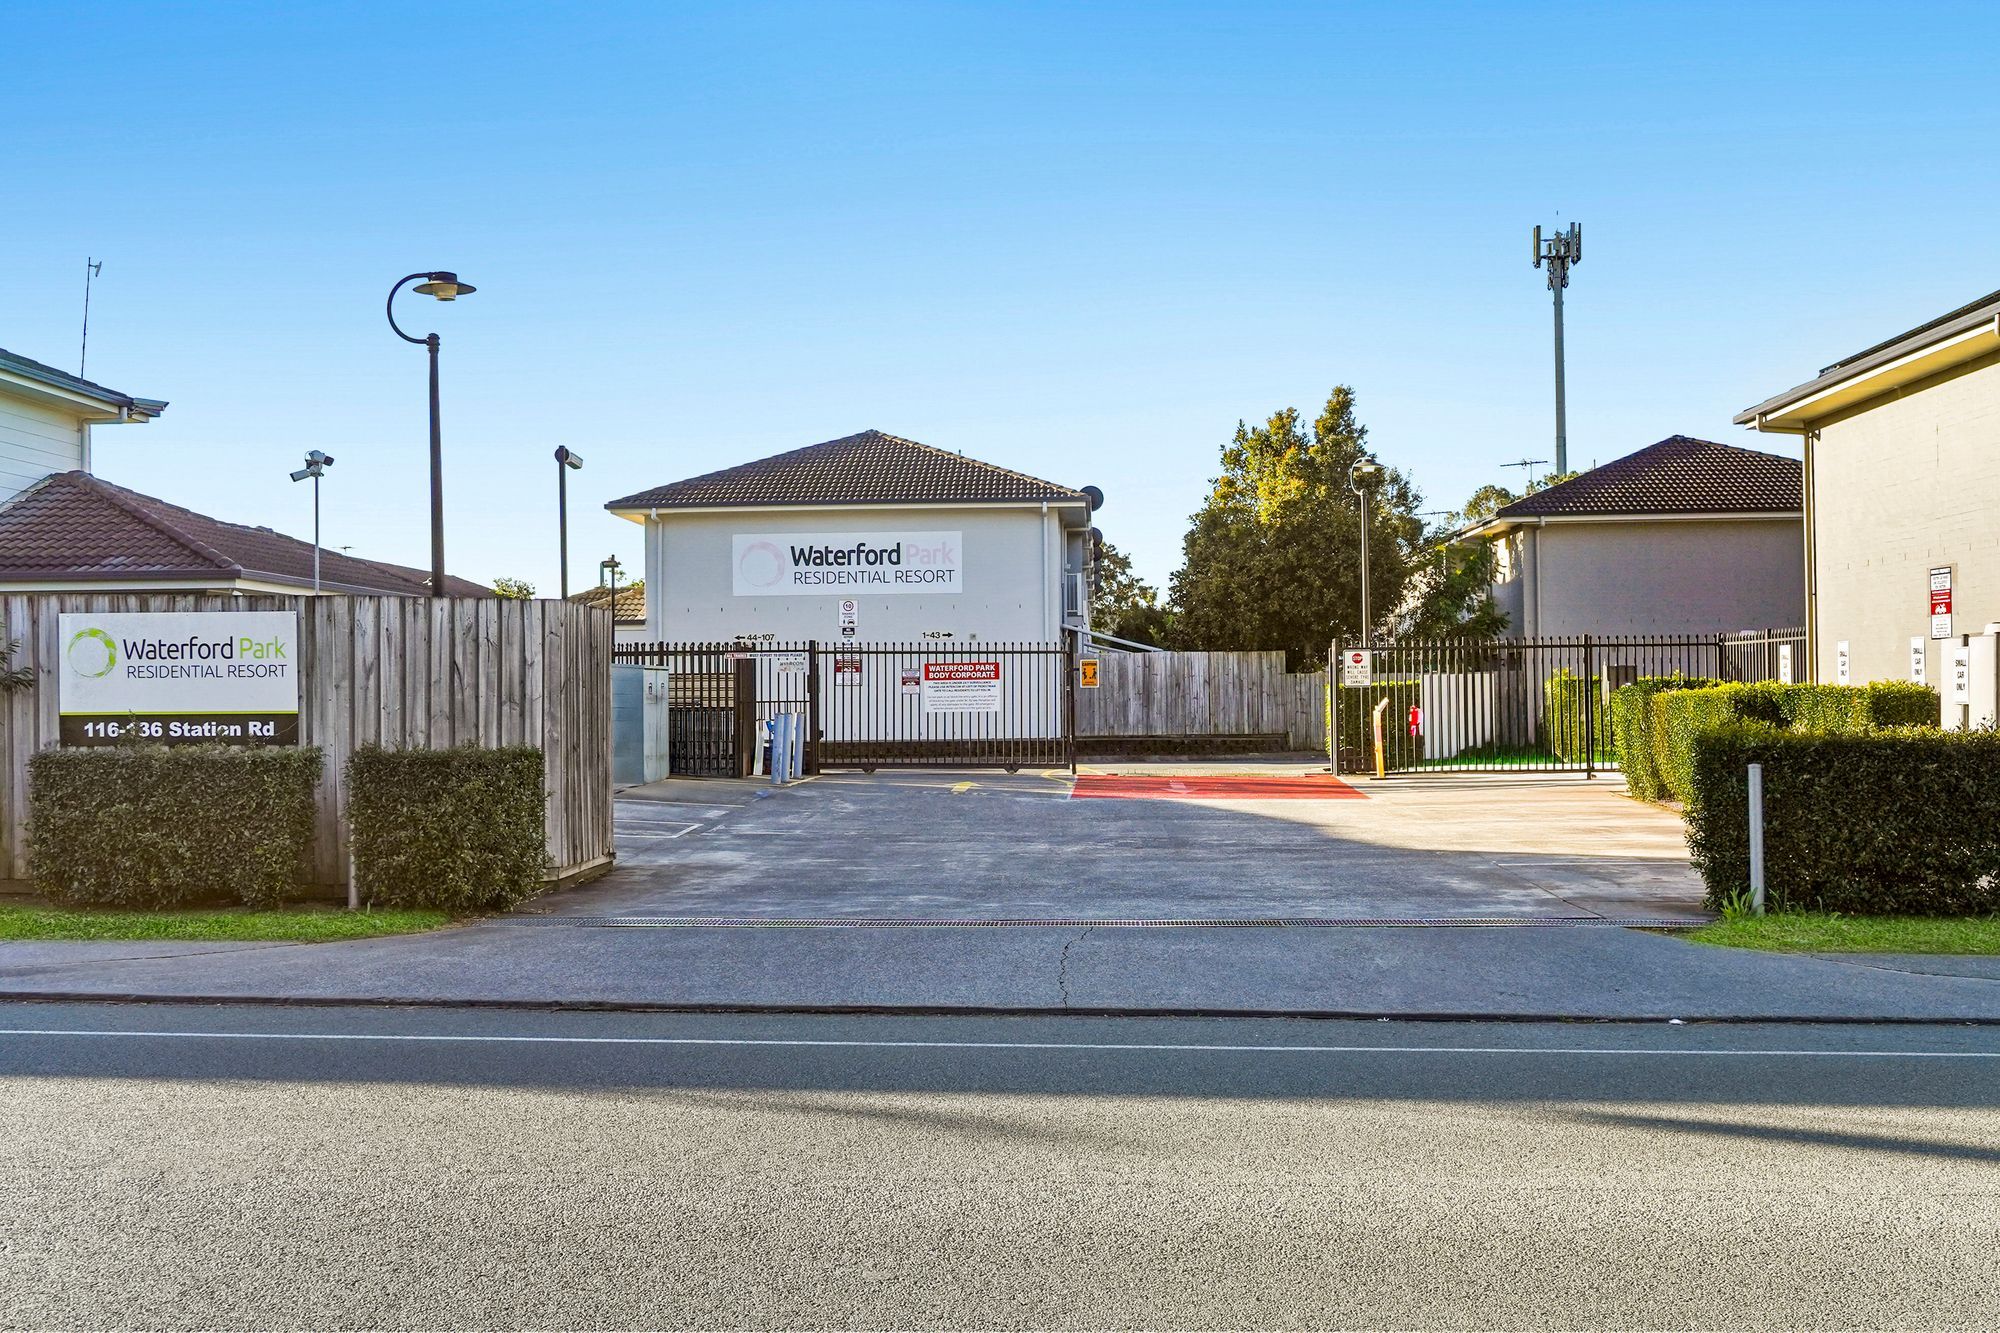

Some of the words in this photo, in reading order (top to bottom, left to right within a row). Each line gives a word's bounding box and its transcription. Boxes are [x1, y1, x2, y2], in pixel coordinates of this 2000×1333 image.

[790, 542, 901, 566] Waterford
[905, 542, 954, 565] Park
[794, 570, 890, 584] RESIDENTIAL
[895, 569, 955, 583] RESORT
[123, 636, 233, 660] Waterford
[239, 636, 287, 659] Park
[928, 664, 974, 672] WATERFORD
[1955, 659, 1967, 667] SMALL
[127, 664, 223, 679] RESIDENTIAL
[227, 664, 287, 678] RESORT
[1957, 671, 1965, 679] CAR
[1956, 683, 1966, 691] ONLY
[168, 721, 242, 737] Station
[248, 720, 275, 737] Rd
